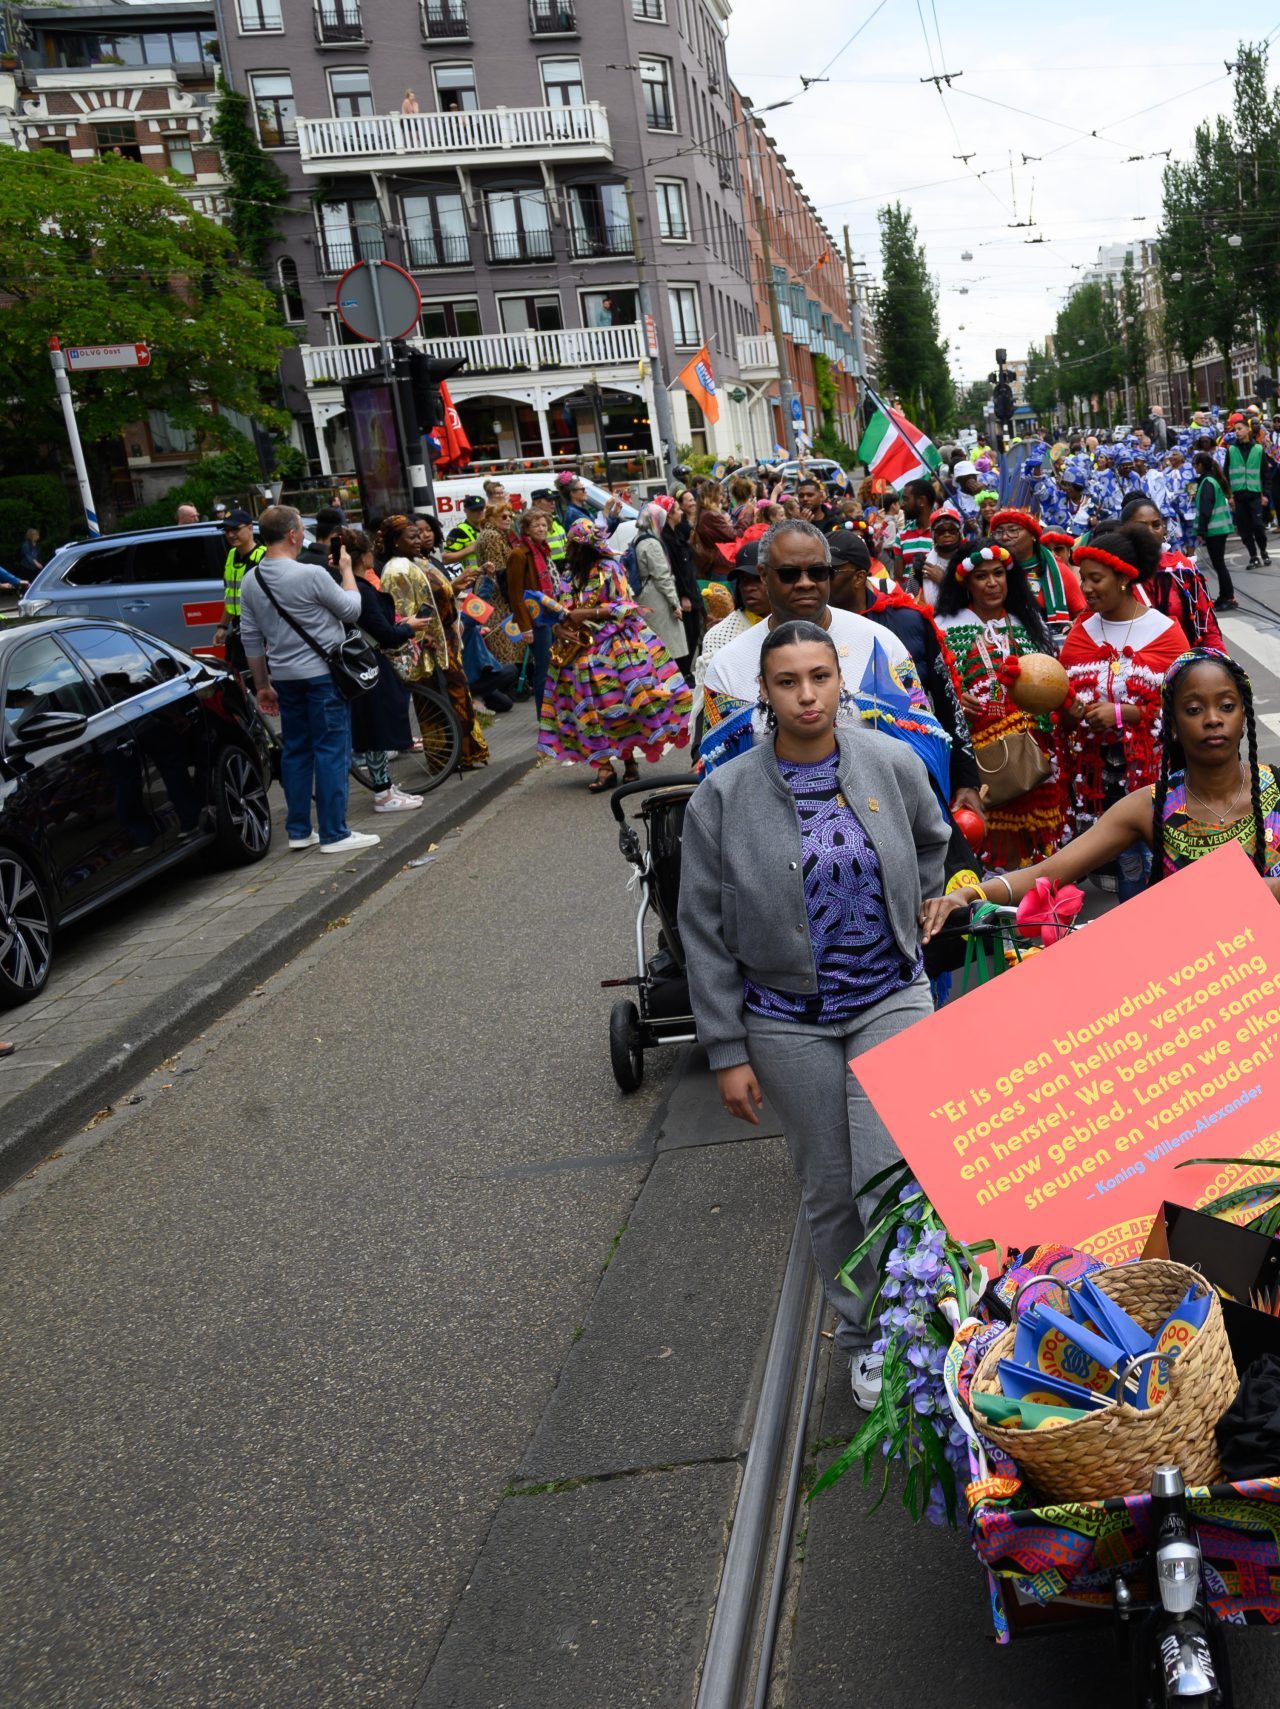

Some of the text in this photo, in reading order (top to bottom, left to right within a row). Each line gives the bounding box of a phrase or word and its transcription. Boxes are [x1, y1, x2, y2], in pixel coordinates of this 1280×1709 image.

[80, 349, 101, 357] OLVG
[953, 955, 1267, 1157] proces van heling, verzoening
[960, 1155, 991, 1180] en
[990, 1102, 1076, 1161] herstel.
[1074, 1079, 1115, 1106] We
[1115, 1016, 1217, 1082] betreden
[969, 1087, 992, 1107] is
[995, 1051, 1053, 1097] geen
[1052, 981, 1167, 1055] blauwdruk
[1168, 951, 1216, 986] voor
[1216, 927, 1255, 958] het
[976, 1155, 1041, 1207] nieuw
[1047, 1100, 1133, 1165] gebied.
[1132, 1062, 1196, 1106] Laten
[1197, 1040, 1231, 1065] we
[1024, 1148, 1112, 1210] steunen
[1114, 1128, 1145, 1152] en
[1095, 1160, 1146, 1195] Koning
[1143, 1084, 1263, 1162] Willem-Alexander
